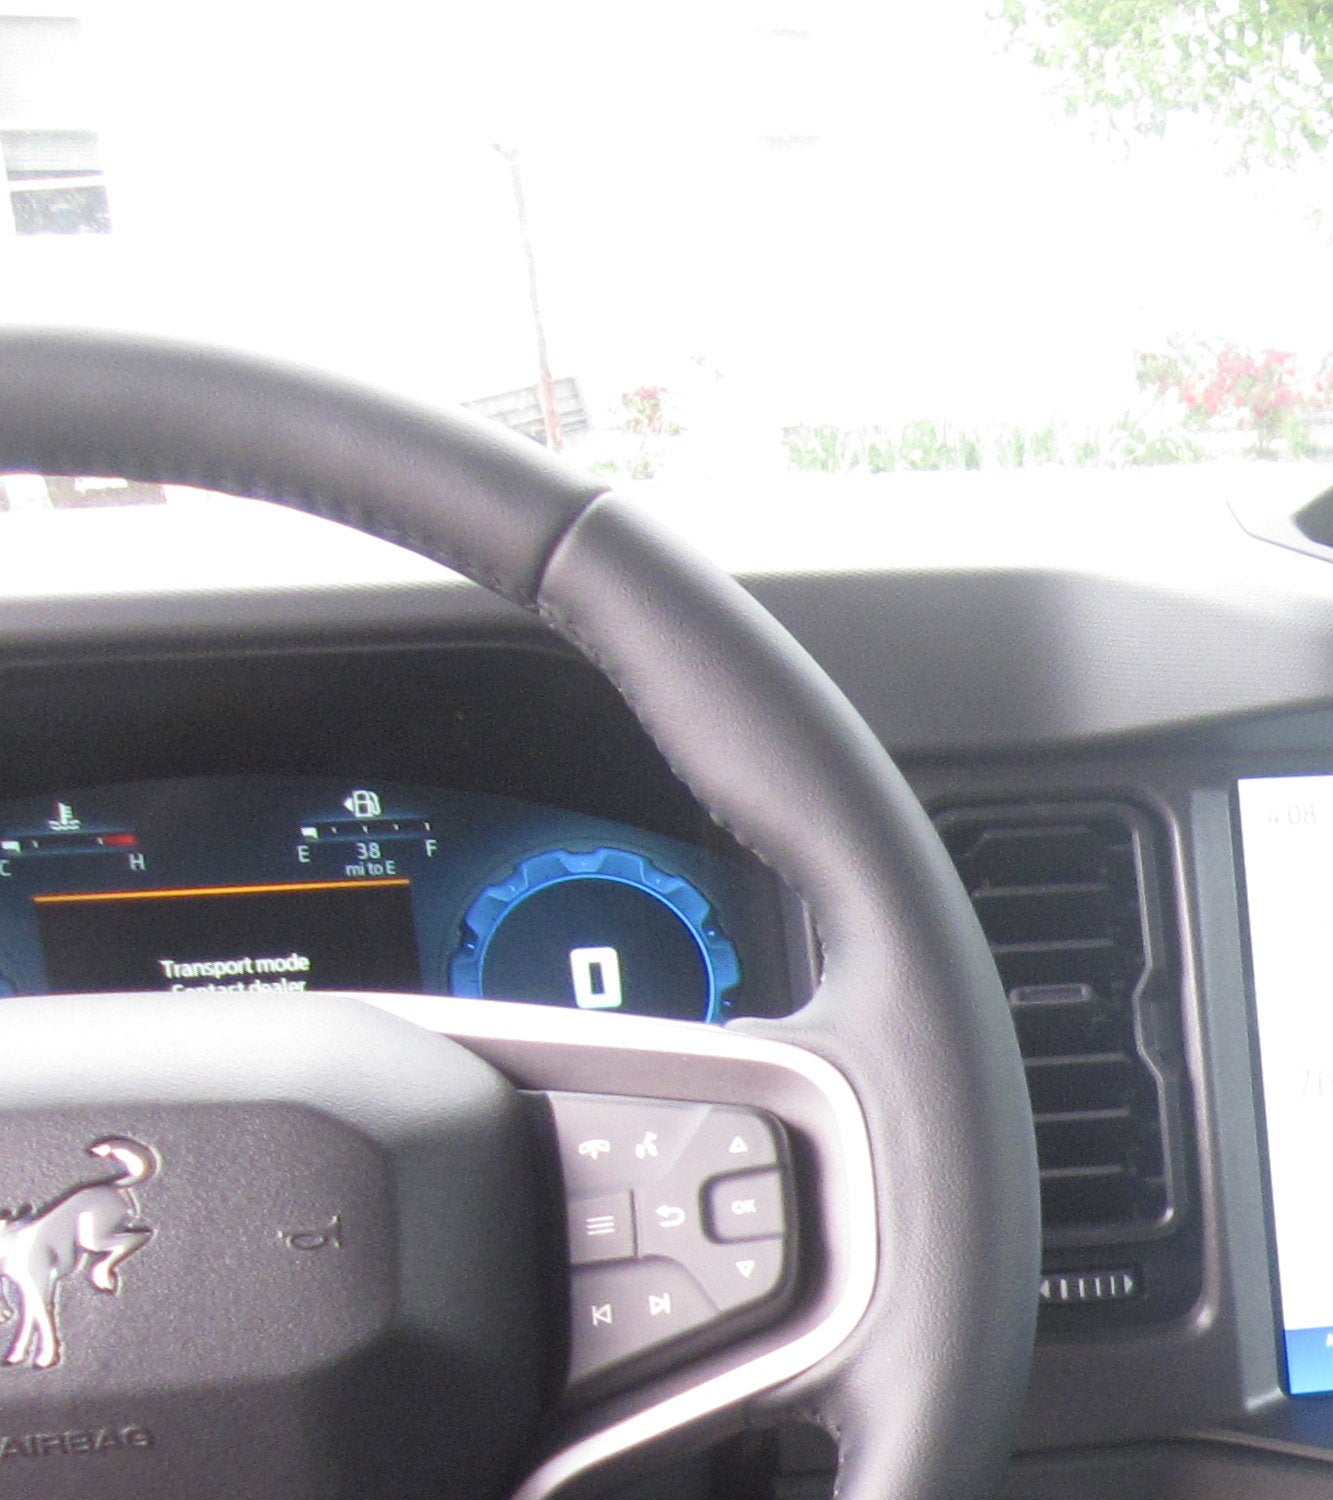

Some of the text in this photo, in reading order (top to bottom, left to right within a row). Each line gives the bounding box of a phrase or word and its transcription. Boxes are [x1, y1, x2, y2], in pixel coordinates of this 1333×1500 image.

[297, 845, 310, 864] E
[355, 842, 382, 861] 38
[425, 839, 438, 858] F
[129, 853, 146, 871] H
[345, 860, 396, 877] mi to E
[160, 953, 310, 984] Transport mode
[569, 946, 623, 1010] 0
[731, 1198, 758, 1215] OK
[0, 1423, 156, 1459] AIRBAG
